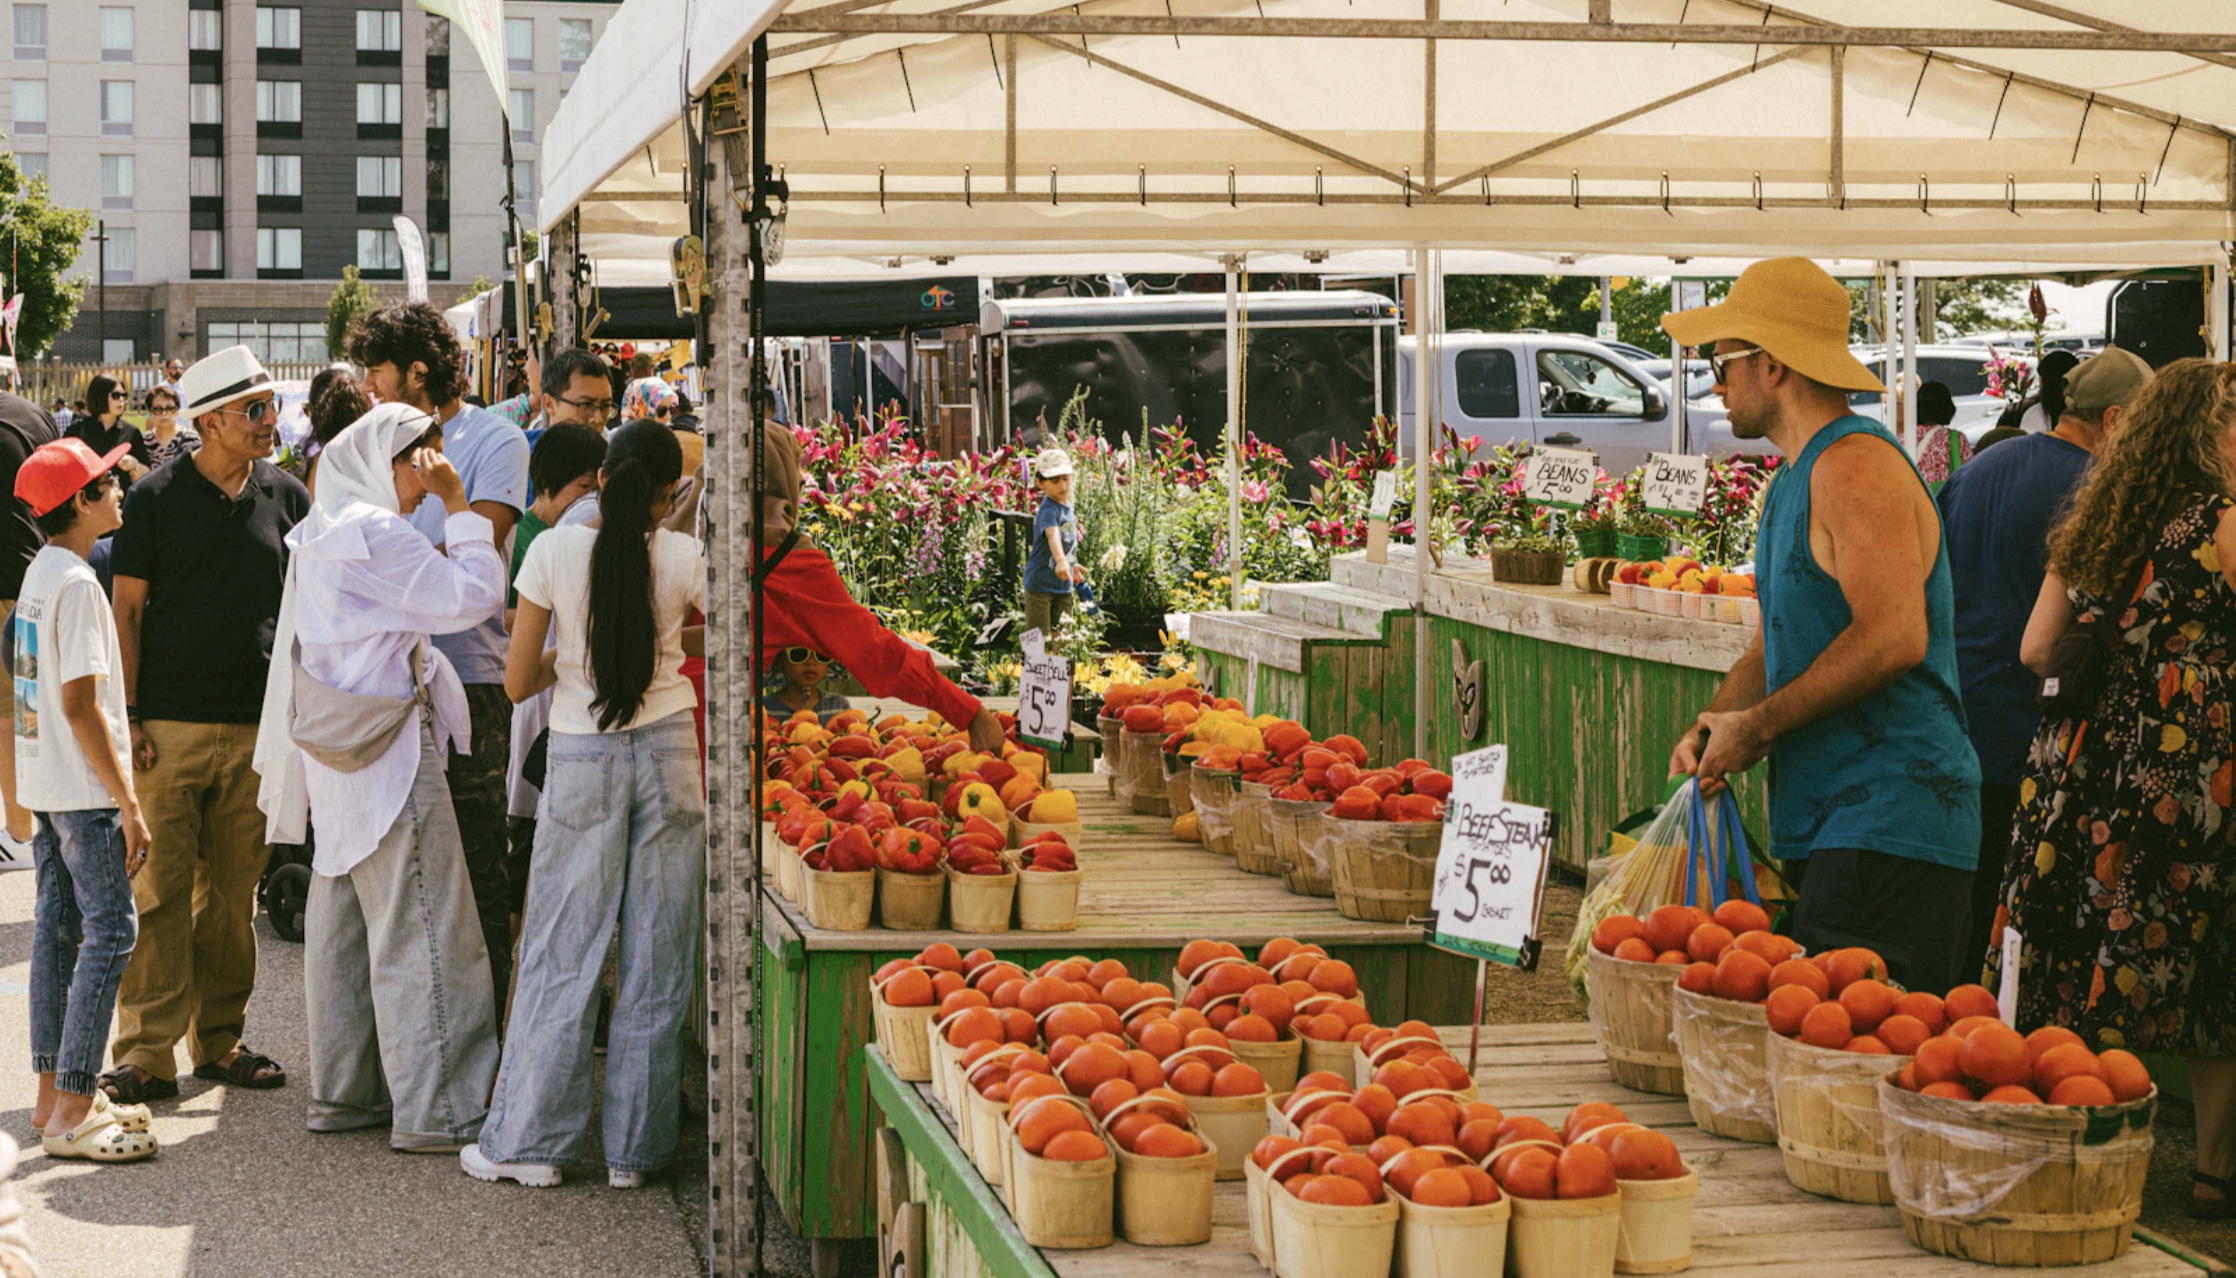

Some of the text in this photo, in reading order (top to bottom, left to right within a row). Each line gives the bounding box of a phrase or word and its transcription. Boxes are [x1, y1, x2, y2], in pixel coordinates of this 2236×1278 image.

[1536, 462, 1589, 485] BEANS
[1656, 460, 1697, 486] BEANS
[1457, 803, 1543, 852] BEEFSTEAK
